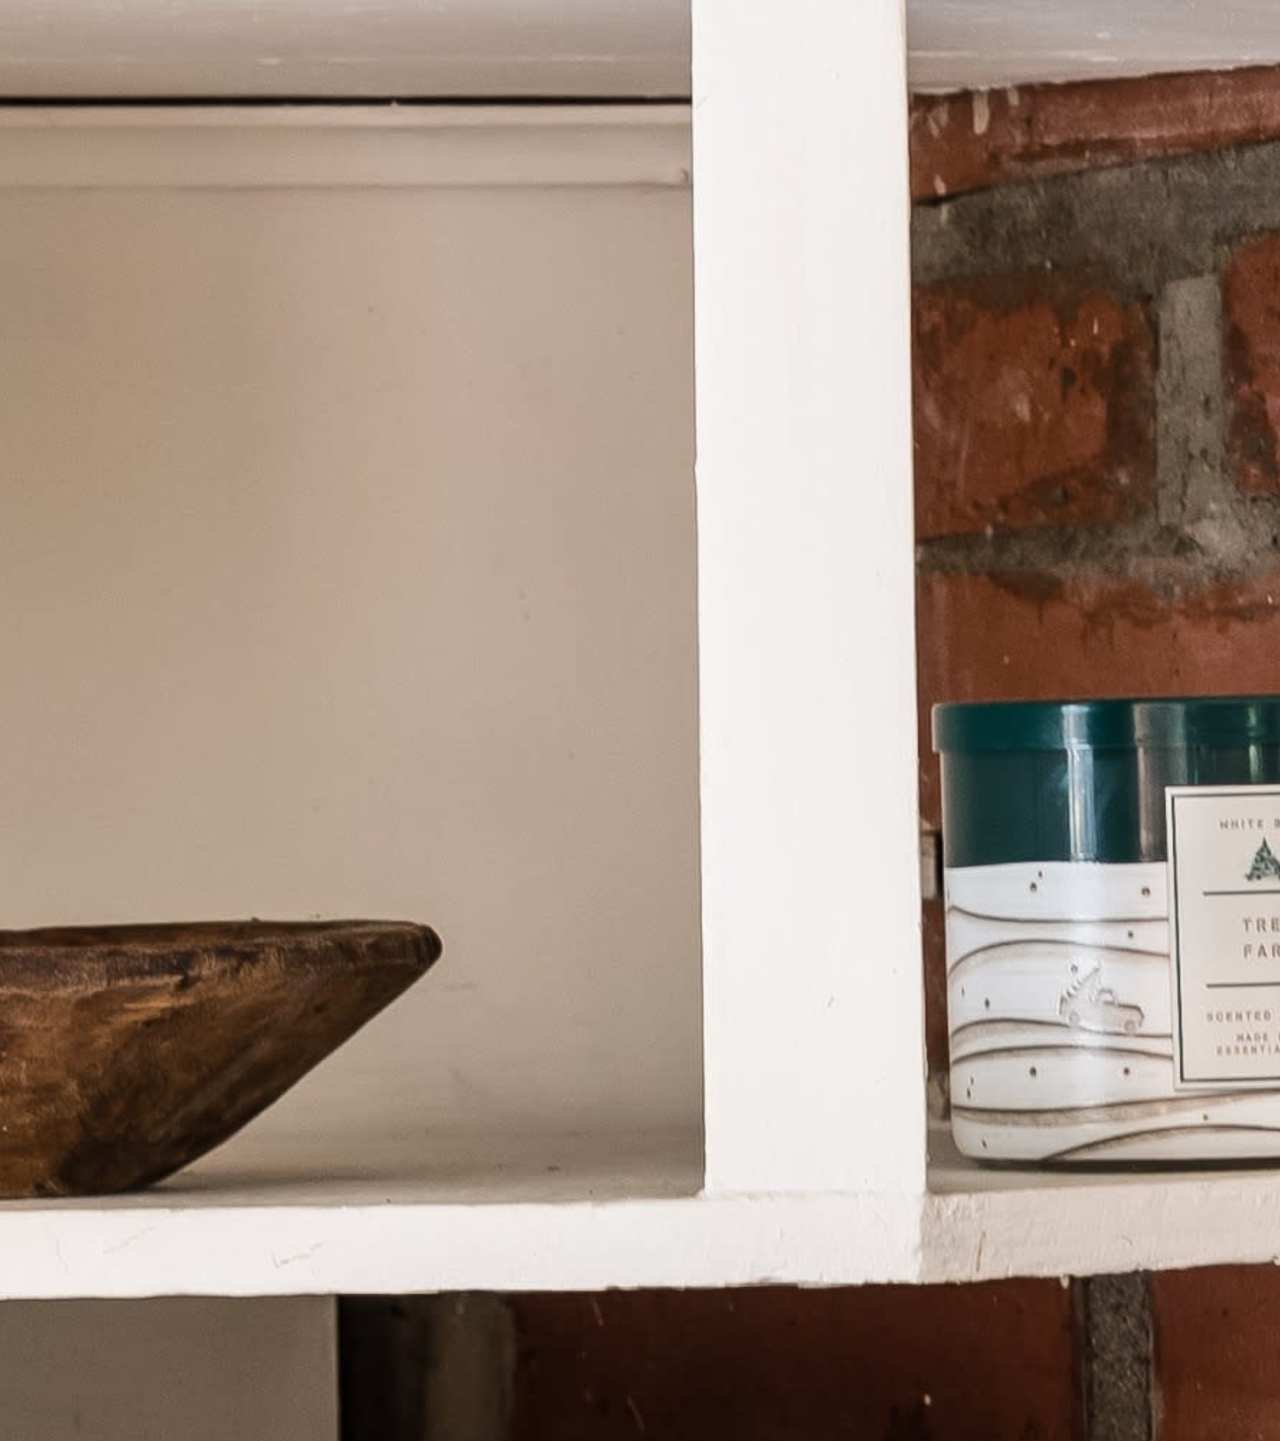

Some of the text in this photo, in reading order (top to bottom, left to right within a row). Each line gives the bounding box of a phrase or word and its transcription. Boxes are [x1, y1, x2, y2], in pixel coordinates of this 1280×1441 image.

[1219, 818, 1265, 830] WHITE
[1206, 1009, 1272, 1022] SCENTED
[1235, 1031, 1269, 1043] MADE
